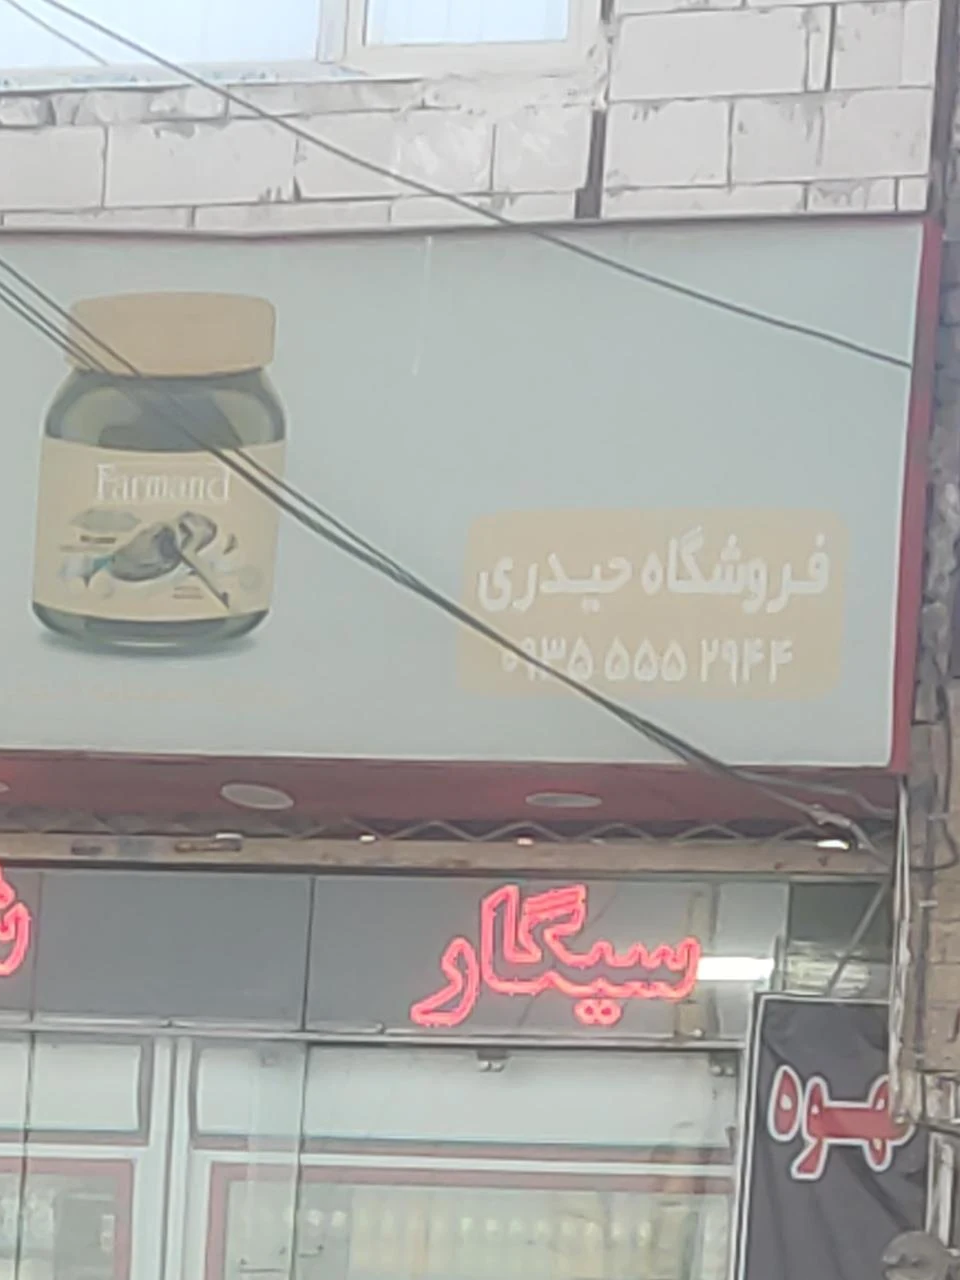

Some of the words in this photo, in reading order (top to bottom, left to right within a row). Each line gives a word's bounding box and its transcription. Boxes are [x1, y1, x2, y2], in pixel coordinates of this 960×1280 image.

[95, 462, 233, 503] Farmand
[476, 552, 633, 614] حیدری
[640, 525, 831, 614] فروشگاه
[604, 635, 688, 682] ۵۵۵
[700, 637, 794, 686] ۲۹۴۴
[409, 882, 702, 1028] سیگار
